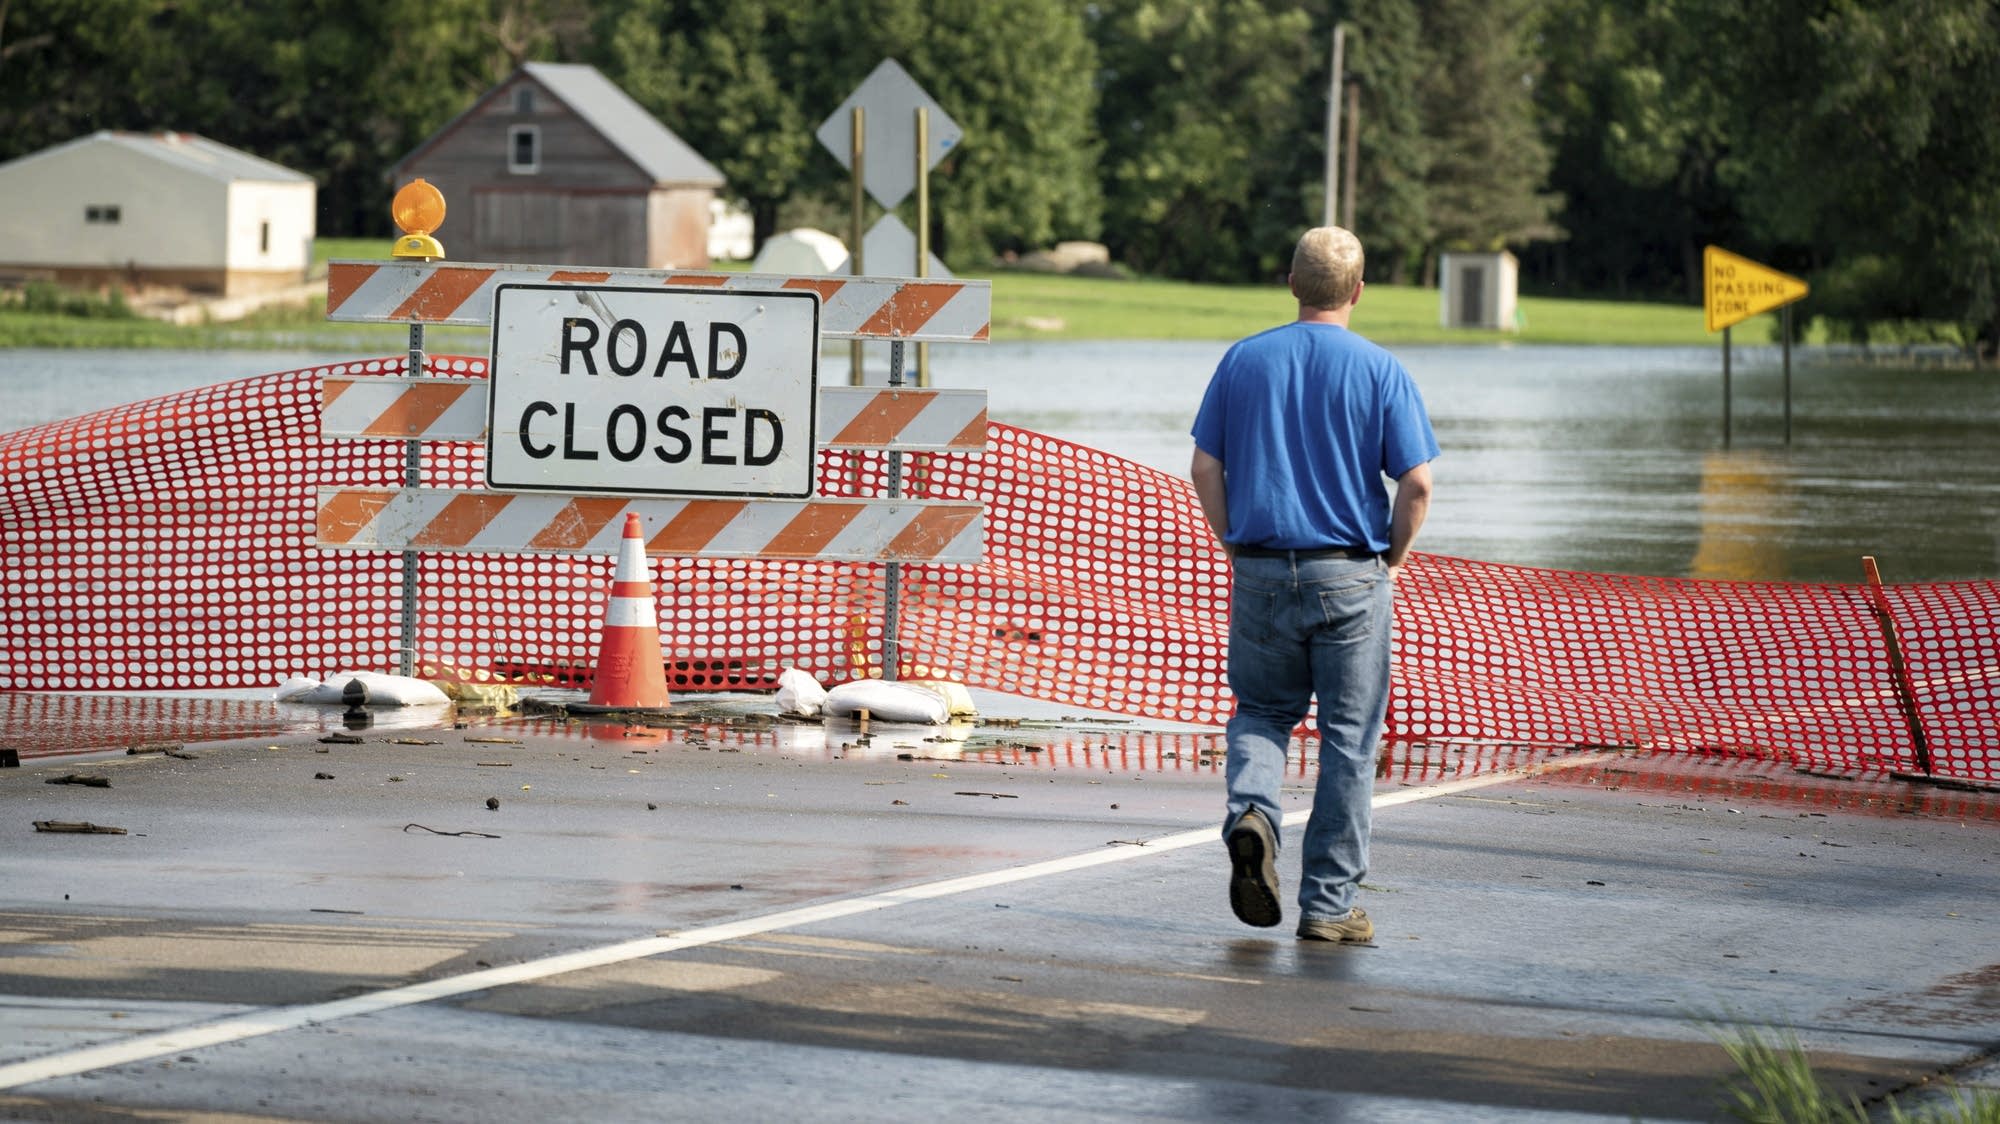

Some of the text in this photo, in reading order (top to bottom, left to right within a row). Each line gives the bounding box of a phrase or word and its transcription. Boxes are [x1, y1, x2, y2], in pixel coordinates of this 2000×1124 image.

[1714, 266, 1736, 279] NO
[1714, 282, 1785, 296] PASSING
[1715, 301, 1749, 313] ZONE
[560, 317, 747, 380] ROAD
[519, 401, 784, 466] CLOSED
